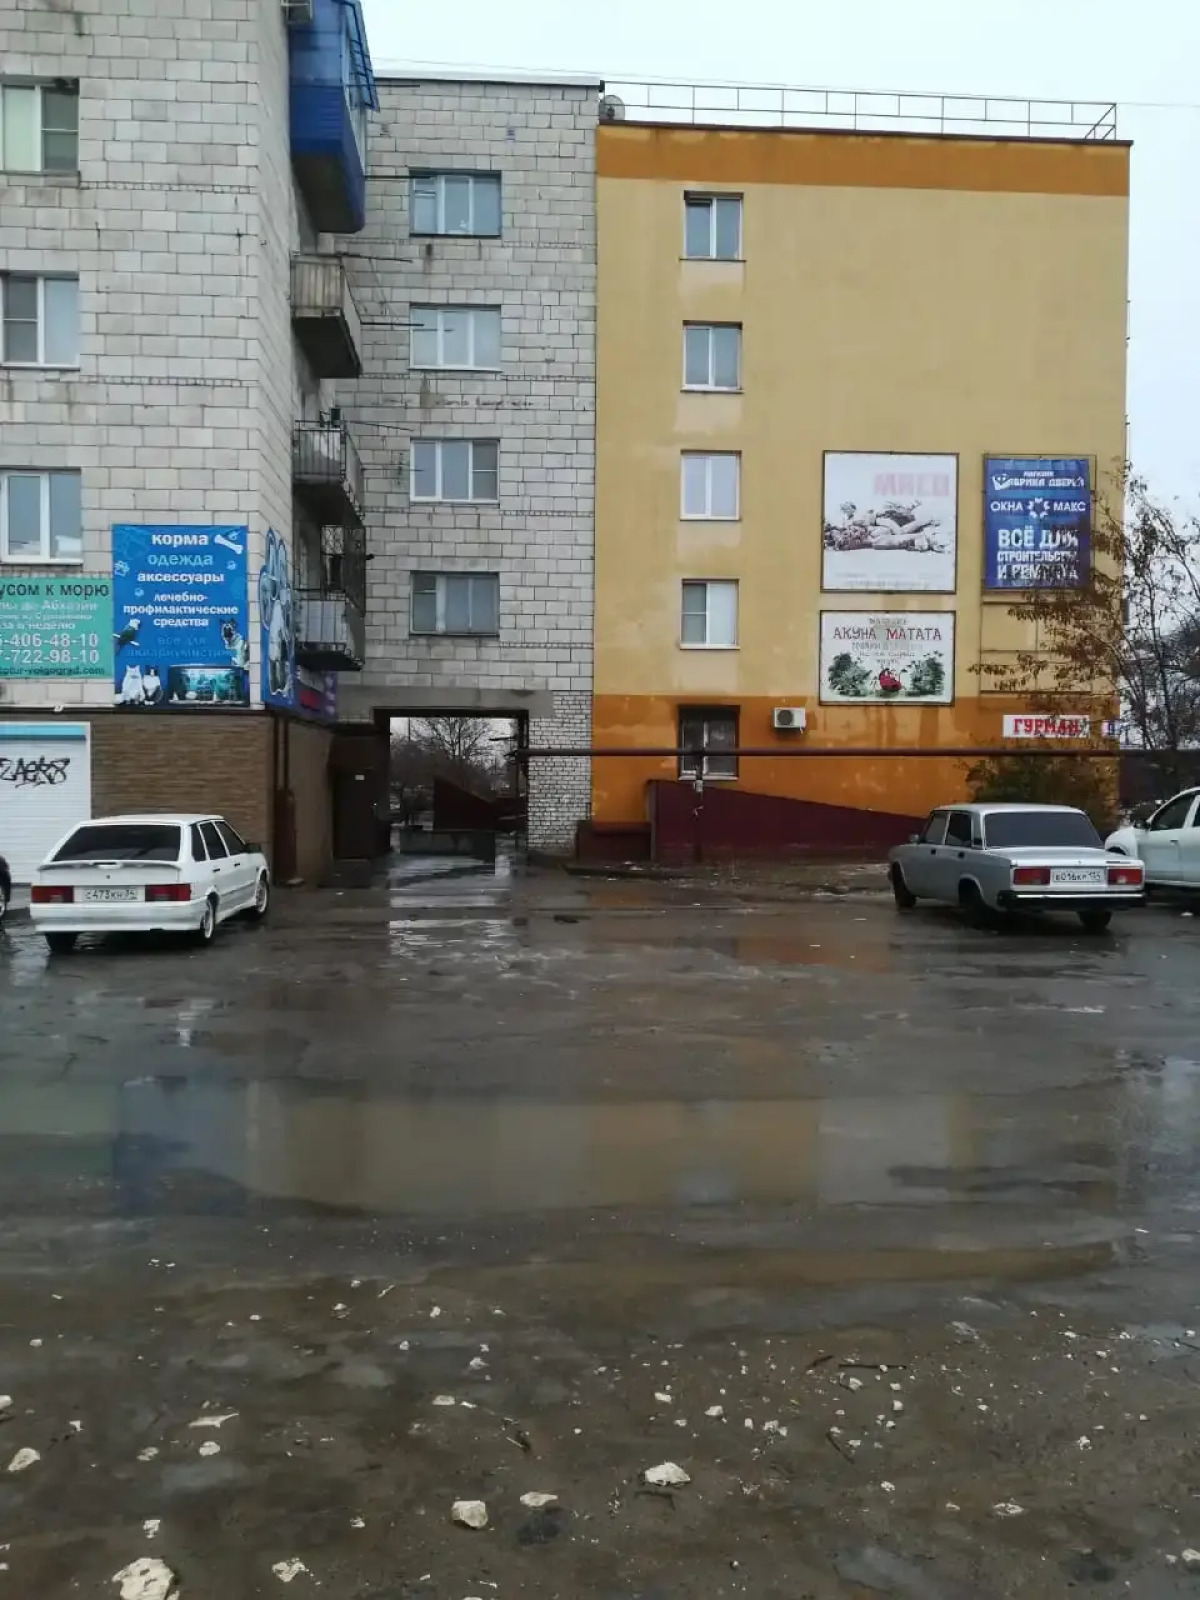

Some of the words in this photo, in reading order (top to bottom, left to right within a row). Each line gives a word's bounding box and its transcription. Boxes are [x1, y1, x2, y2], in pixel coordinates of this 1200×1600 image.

[990, 501, 1023, 512] ОКНА
[1053, 501, 1086, 512] МАКС
[152, 535, 209, 548] корма
[998, 525, 1034, 547] ВСЁ
[148, 554, 213, 567] одежда
[137, 572, 225, 585] аксессуары
[998, 565, 1007, 579] И
[60, 585, 110, 600] морю
[154, 592, 208, 602] лечебно-
[123, 604, 239, 615] профилактические
[153, 618, 209, 629] средства
[0, 633, 99, 647] -406-48-10
[833, 627, 877, 641] АКУНА
[886, 627, 942, 641] МАТАТА
